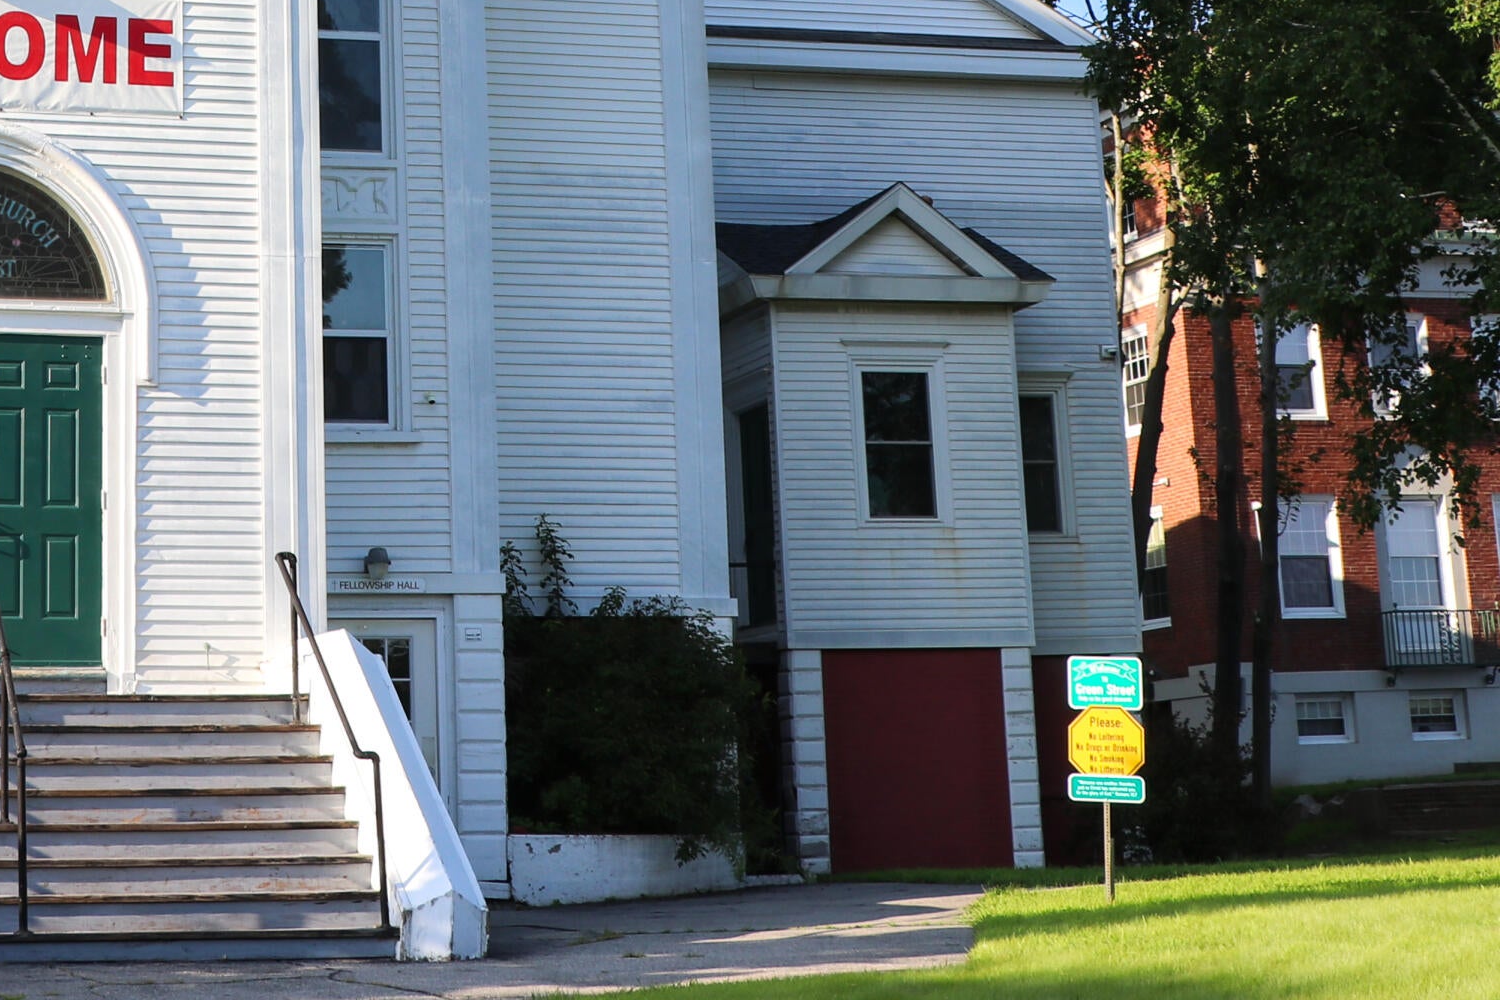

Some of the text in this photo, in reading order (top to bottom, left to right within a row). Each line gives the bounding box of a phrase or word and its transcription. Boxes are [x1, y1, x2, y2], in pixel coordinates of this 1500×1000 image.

[339, 580, 420, 591] FELLOWSHIP HALL
[1075, 682, 1136, 697] Green Street
[1089, 716, 1123, 728] Please:
[1113, 743, 1138, 754] Drinking
[1099, 754, 1125, 765] Smoking
